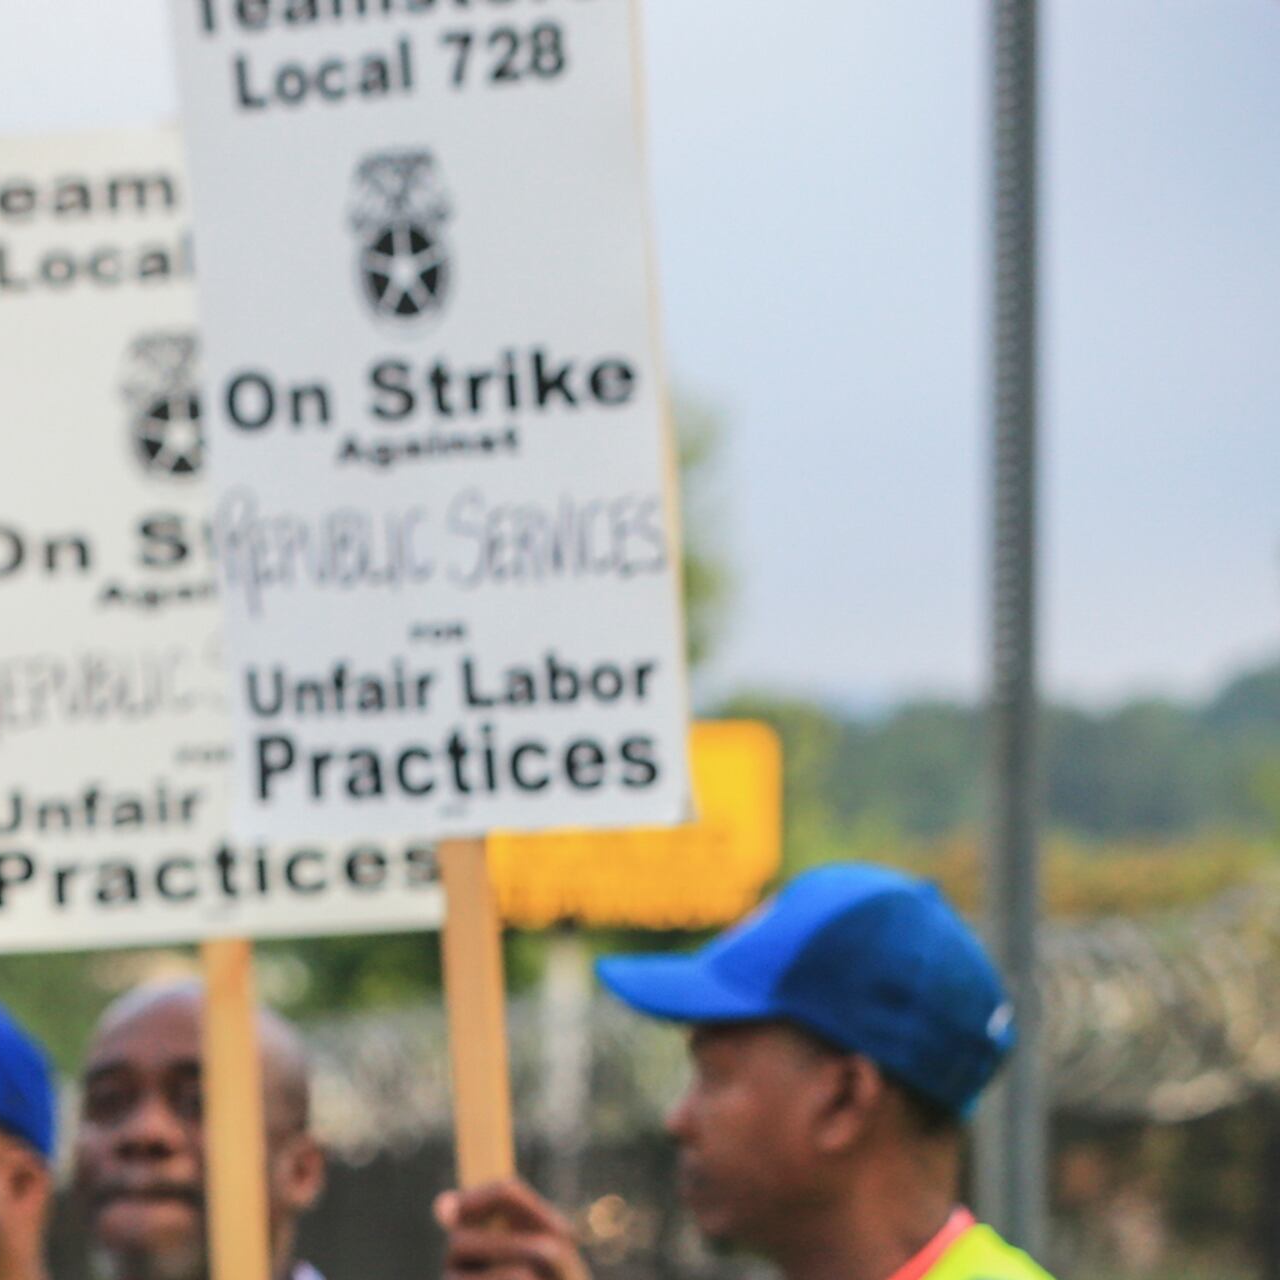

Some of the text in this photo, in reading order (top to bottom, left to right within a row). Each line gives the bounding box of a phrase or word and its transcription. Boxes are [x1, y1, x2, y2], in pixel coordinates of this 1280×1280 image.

[233, 22, 566, 109] Local 728
[224, 346, 637, 432] On Strike
[246, 650, 657, 719] Unfair Labor
[255, 723, 660, 804] Practices
